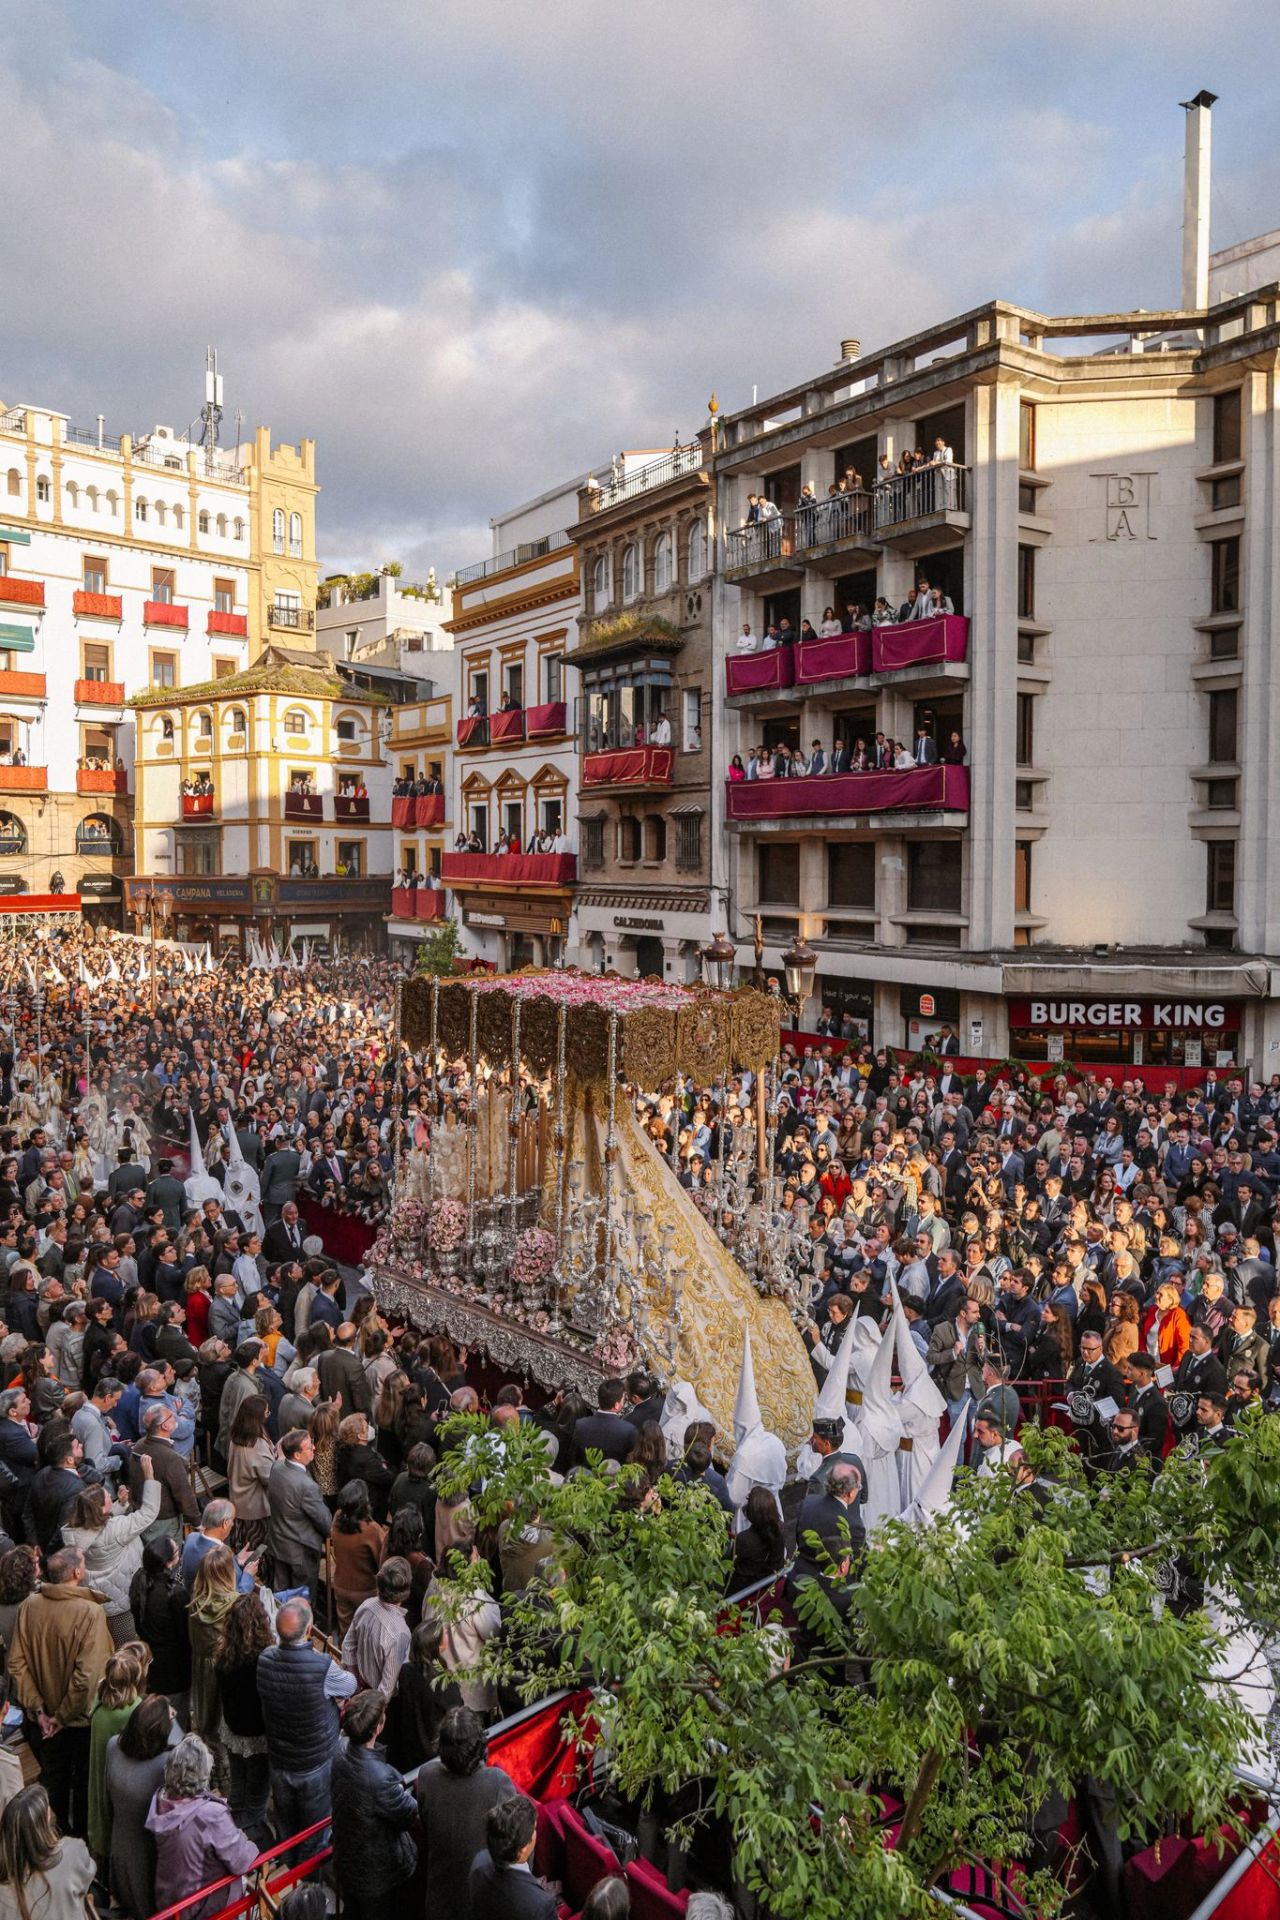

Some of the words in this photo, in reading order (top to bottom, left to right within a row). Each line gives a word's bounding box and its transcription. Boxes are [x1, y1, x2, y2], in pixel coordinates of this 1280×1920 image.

[1109, 509, 1137, 537] A
[176, 888, 211, 898] CAMPANA
[613, 915, 665, 931] CALZEDONIA
[1030, 1002, 1142, 1026] BURGER
[1153, 1003, 1225, 1027] KING
